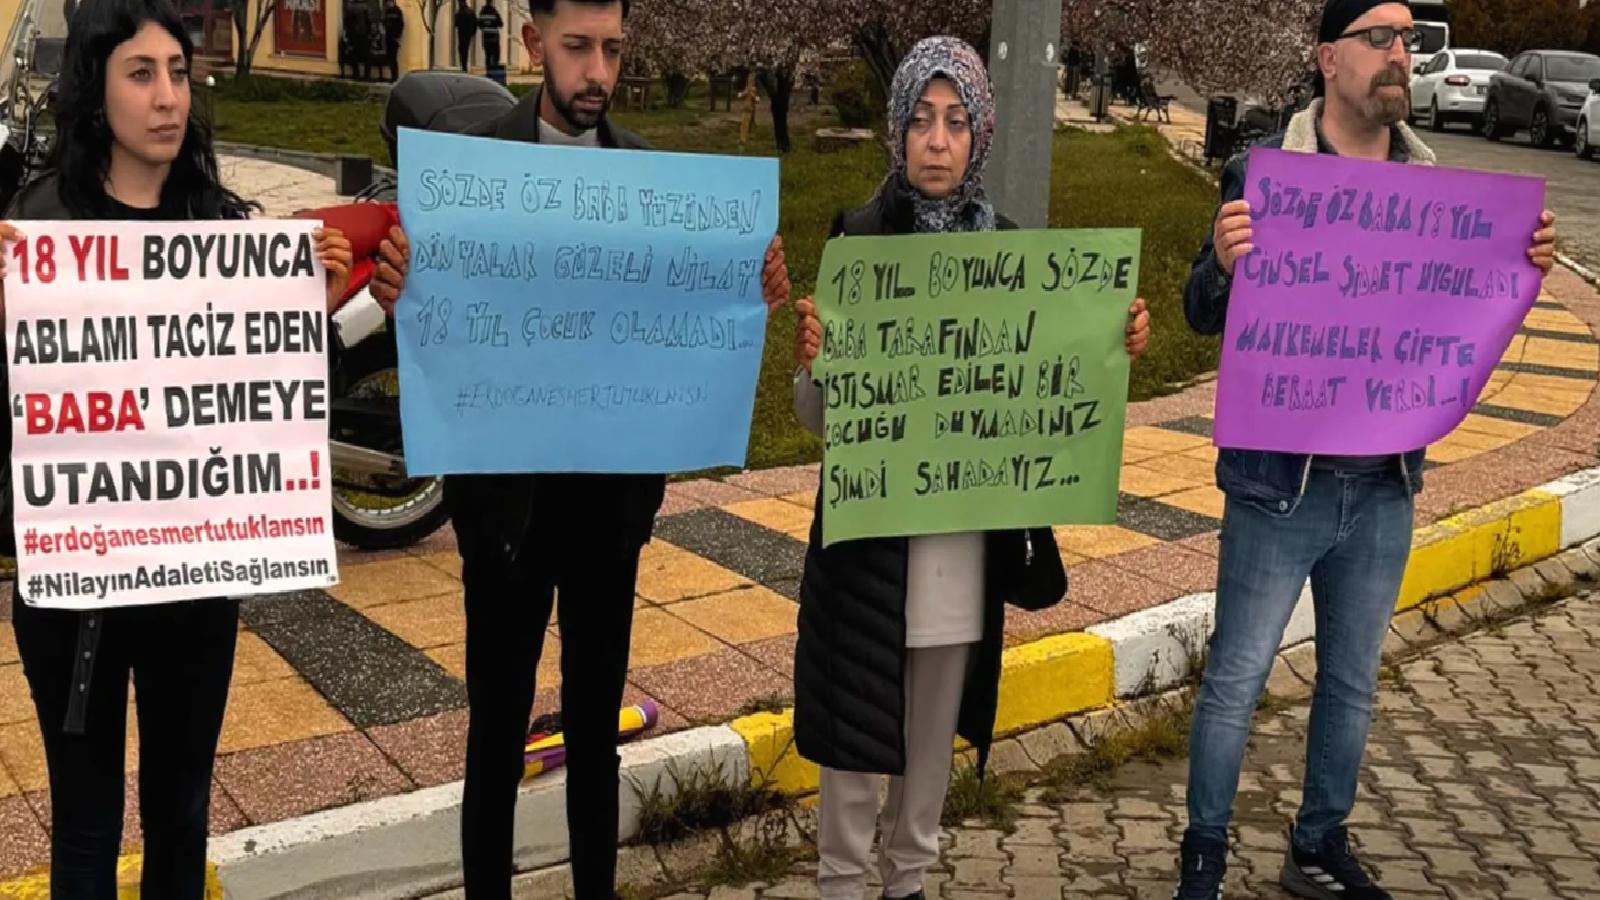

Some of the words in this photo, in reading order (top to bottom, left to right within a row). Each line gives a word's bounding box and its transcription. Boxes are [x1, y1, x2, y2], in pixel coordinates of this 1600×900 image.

[418, 169, 508, 212] SÖZDE
[521, 172, 562, 213] ÖZ
[573, 176, 628, 224] BABA
[638, 189, 761, 236] YÜZÜNDEN
[1249, 176, 1323, 229] SÖZDE
[1326, 184, 1358, 225] ÖZ
[1357, 191, 1411, 233] BABA
[1450, 204, 1493, 241] YIL
[13, 235, 56, 284] 18
[69, 235, 129, 281] YIL
[142, 232, 314, 280] BOYUNCA
[666, 246, 757, 297] NİLAY
[831, 259, 865, 305] 18
[873, 262, 916, 301] YIL
[928, 250, 1026, 299] BOYUNCA
[1041, 247, 1134, 293] SÖZDE
[13, 316, 138, 365] ABLAMI
[147, 302, 237, 359] TACİZ
[245, 310, 323, 355] EDEN
[417, 295, 452, 348] 18
[466, 301, 509, 347] YIL
[521, 306, 597, 347] ÇOCUK
[823, 318, 867, 362] BABA
[877, 310, 1036, 361] TARAFINDAN
[1394, 328, 1475, 367] ÇİFTE
[938, 361, 1025, 400] EDİLEN
[1036, 355, 1085, 400] BİR
[164, 379, 326, 428] DEMEYE
[935, 401, 1102, 440] DUYMADINIZ
[830, 461, 887, 509] ŞİMDİ
[24, 515, 325, 556] #erdoğanesmertutuklansın
[27, 557, 329, 600] #NilayınAdaletiSağlansın
